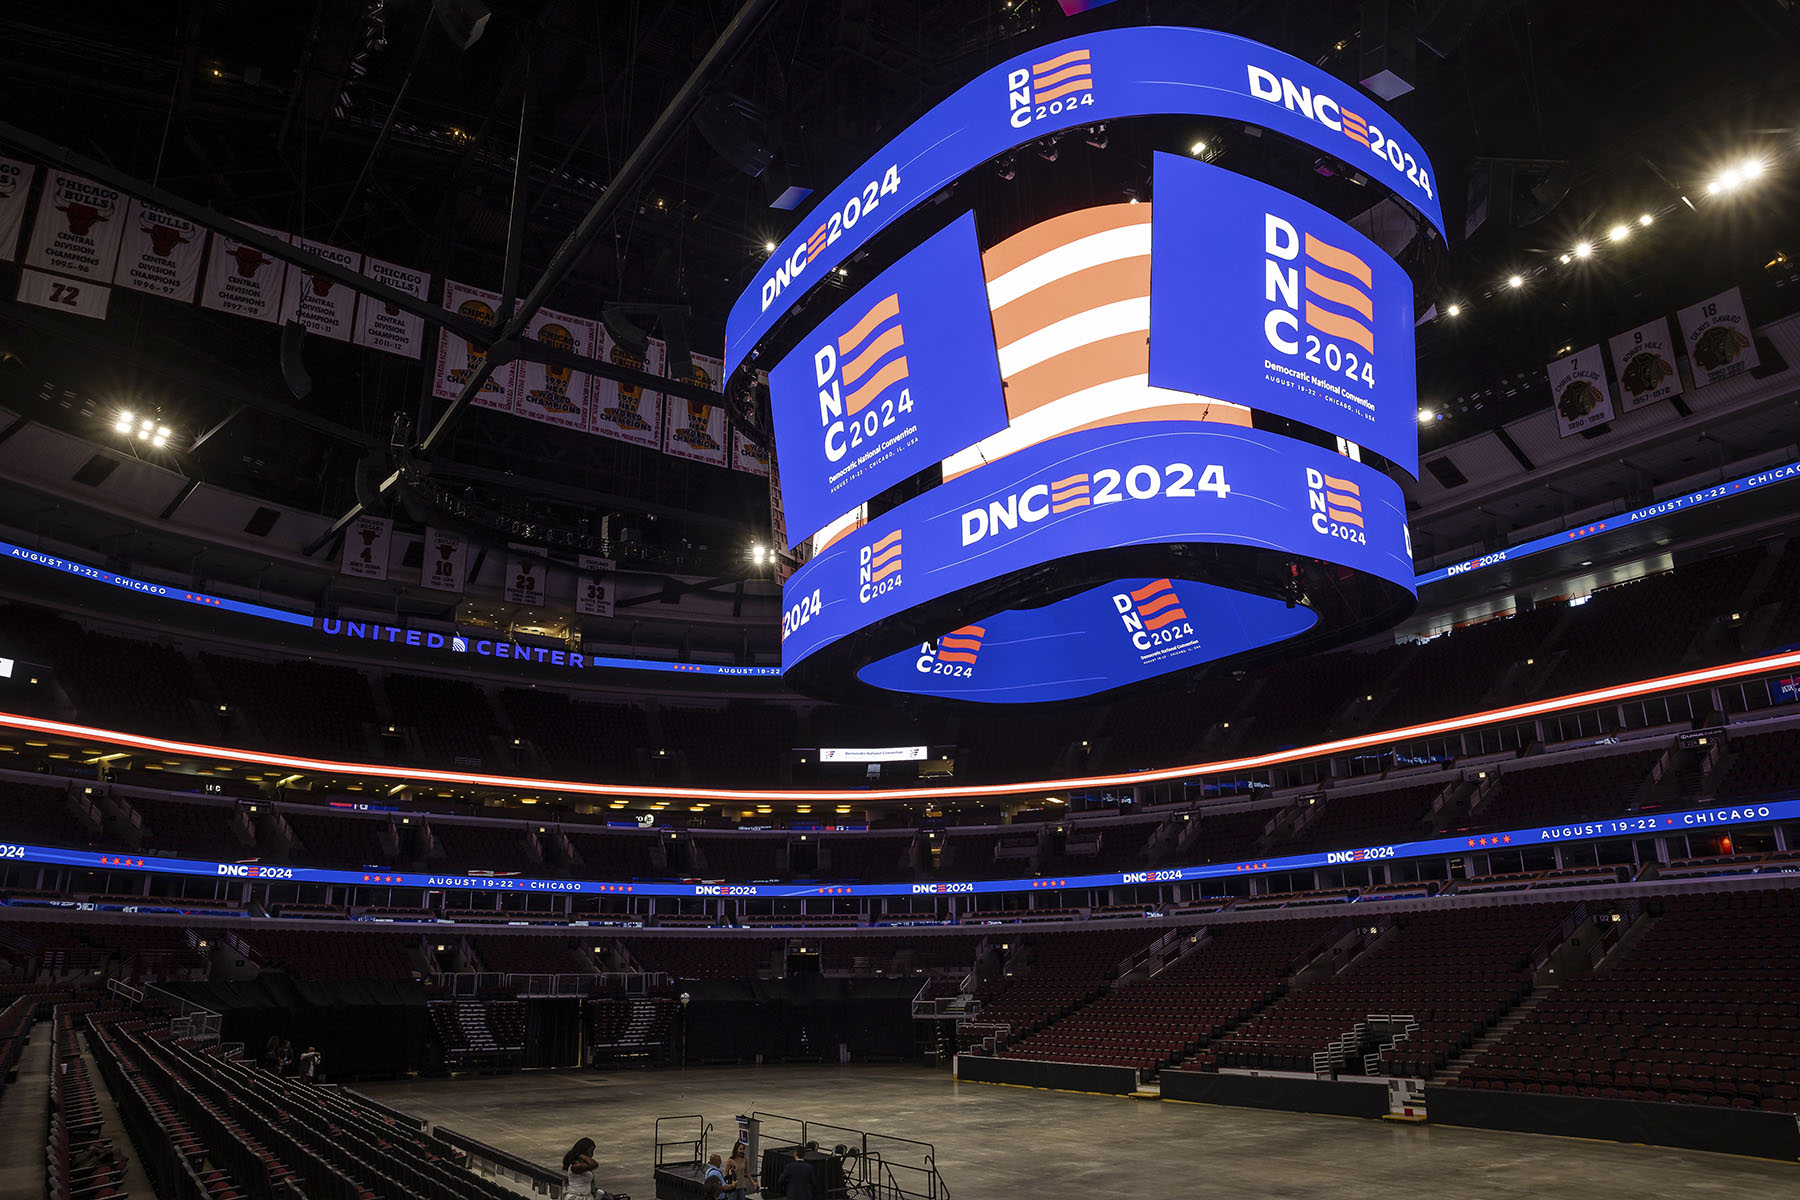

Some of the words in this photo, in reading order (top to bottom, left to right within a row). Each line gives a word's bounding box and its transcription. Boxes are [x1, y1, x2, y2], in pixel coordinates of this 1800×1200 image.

[1035, 92, 1094, 120] 2024
[1367, 126, 1432, 201] 2024
[57, 178, 118, 200] CHICAGO
[64, 189, 109, 209] BULLS
[827, 164, 900, 247] 2024
[148, 212, 190, 230] BULLS
[54, 240, 94, 255] DIVISION
[58, 232, 94, 246] CENTRAL
[45, 248, 99, 265] CHAMPIONS
[142, 254, 176, 268] CENTRAL
[302, 244, 351, 264] CHICAGO
[130, 269, 180, 287] CHAMPIONS
[138, 262, 176, 277] DIVISION
[373, 264, 421, 284] CHICAGO
[226, 284, 260, 298] DIVISION
[228, 276, 260, 289] CENTRAL
[49, 282, 79, 306] 72
[219, 292, 265, 308] CHAMPIONS
[304, 295, 334, 308] CENTRAL
[302, 303, 335, 316] DIVISION
[1702, 303, 1717, 318] 18
[374, 322, 405, 335] DIVISION
[377, 314, 404, 327] CENTRAL
[368, 329, 409, 344] CHAMPIONS
[1634, 332, 1642, 343] 9
[1690, 321, 1710, 340] DENIS
[1623, 345, 1642, 362] BOBBY
[1645, 342, 1663, 350] HULL
[1304, 333, 1374, 390] 2024
[1571, 358, 1578, 370] 7
[1265, 374, 1295, 387] AUGUST
[1298, 384, 1317, 396] 19-22
[1265, 359, 1311, 384] Democratic
[1310, 376, 1340, 395] National
[1340, 385, 1375, 412] Convention
[1555, 375, 1572, 392] CHRIS
[526, 395, 580, 414] CHAMPIONS
[538, 390, 570, 403] WORLD
[600, 414, 652, 432] CHAMPIONS
[612, 409, 642, 420] WORLD
[849, 387, 915, 449] 2024
[673, 434, 720, 451] CHAMPIONS
[683, 428, 711, 440] WORLD
[829, 459, 858, 485] Democratic
[857, 444, 881, 467] National
[882, 424, 918, 451] Convention
[829, 477, 848, 493] AUGUST
[907, 437, 918, 446] USA
[1093, 463, 1230, 506] 2024
[1632, 500, 1682, 520] AUGUST
[1690, 487, 1725, 502] 19-22
[1331, 521, 1366, 545] 2024
[360, 548, 371, 562] 4
[1479, 552, 1506, 566] 2024
[13, 549, 62, 566] AUGUST
[69, 564, 98, 577] 19-22
[115, 578, 165, 594] CHICAGO
[436, 560, 452, 577] 10
[516, 575, 534, 590] 23
[872, 573, 902, 598] 2024
[588, 585, 604, 600] 33
[782, 589, 821, 639] 2024
[322, 618, 445, 649] UNITED
[476, 640, 584, 669] CENTER
[1150, 623, 1195, 648] 2024
[932, 661, 972, 678] 2024
[1542, 825, 1602, 838] AUGUST
[1612, 819, 1656, 831] 19-22
[1684, 807, 1769, 824] CHICAGO
[1364, 847, 1394, 859] 2024
[259, 868, 292, 878] 2024
[1156, 870, 1182, 880] 2024
[531, 882, 580, 890] CHICAGO
[730, 887, 756, 895] 2024
[946, 884, 973, 892] 2024
